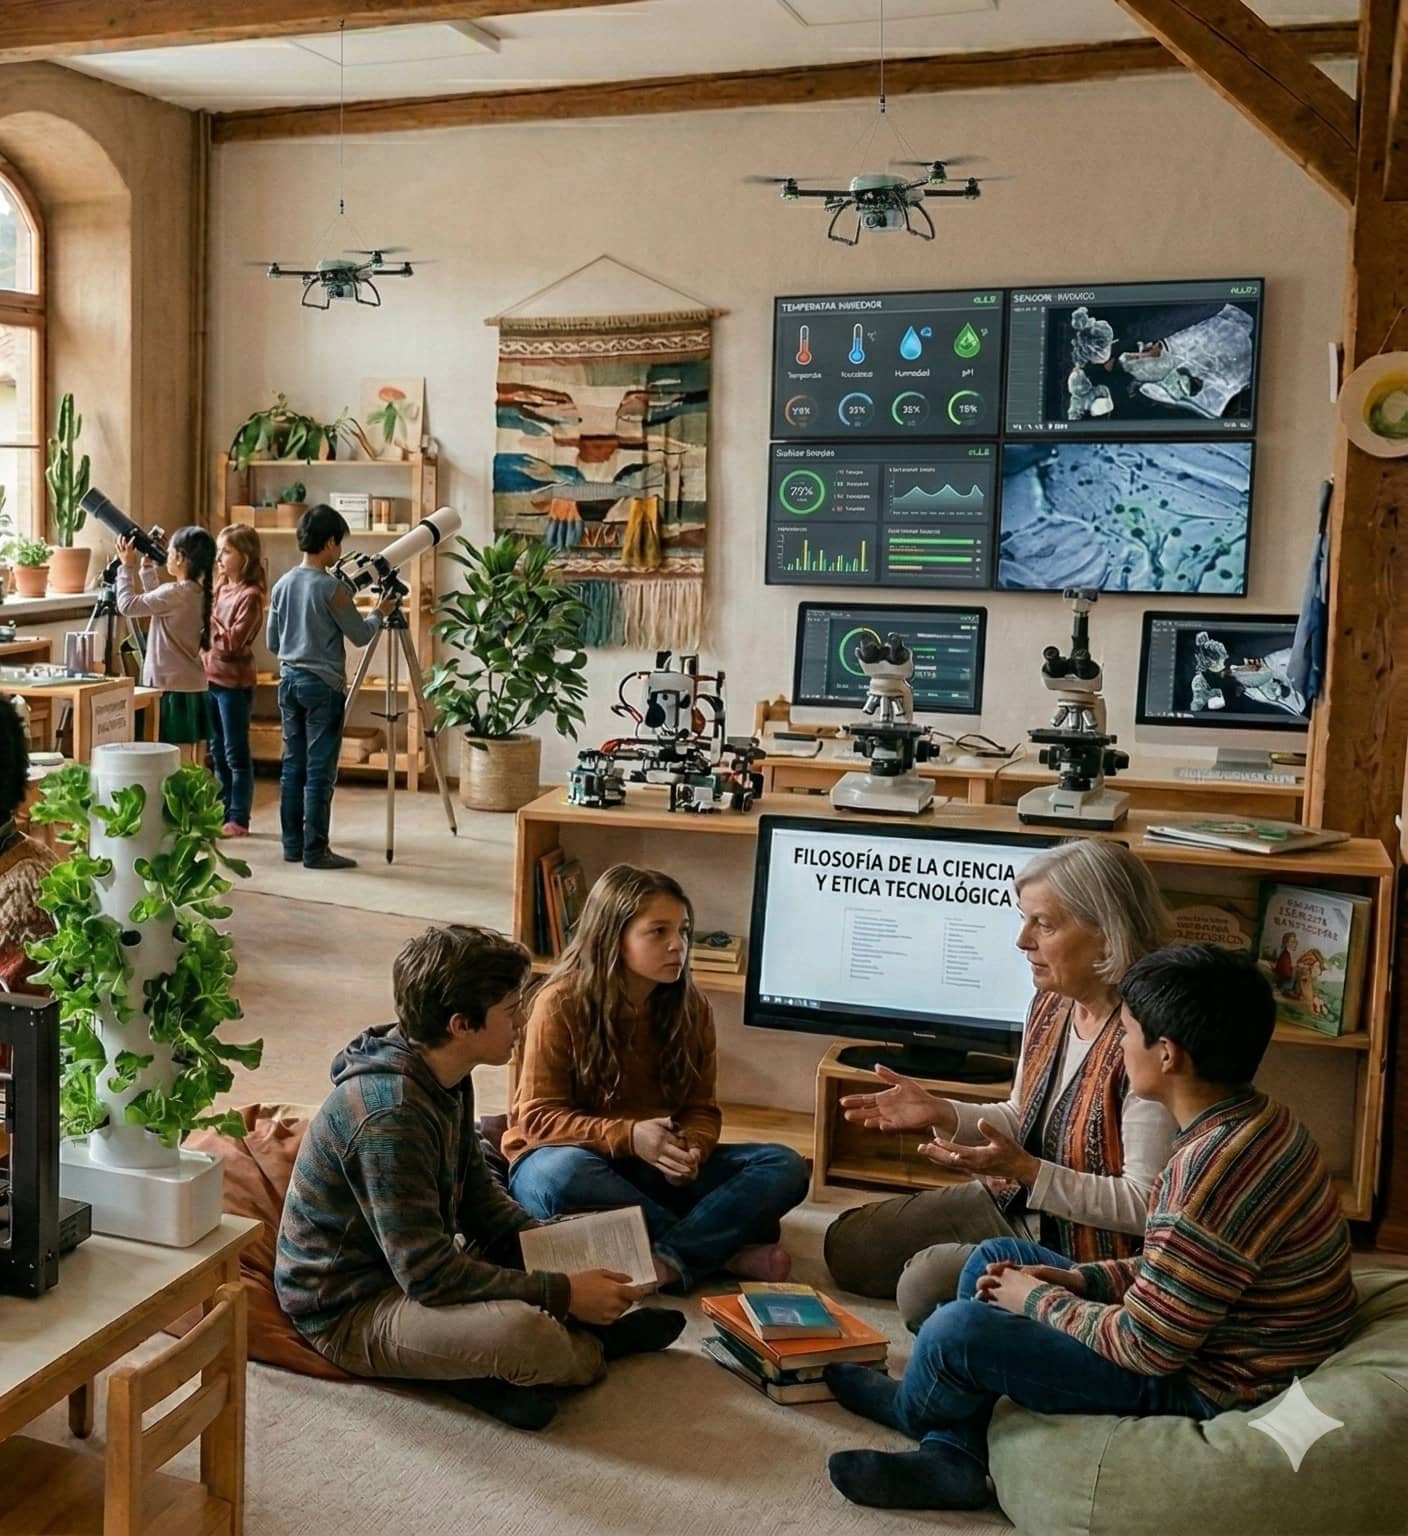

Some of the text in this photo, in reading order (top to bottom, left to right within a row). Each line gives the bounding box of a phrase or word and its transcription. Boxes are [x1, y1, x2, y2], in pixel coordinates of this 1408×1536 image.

[793, 847, 1016, 881] FILOSOFÍA DE LA CIENCIA
[816, 873, 1012, 908] Y ETICA TECNOLÓGICA
